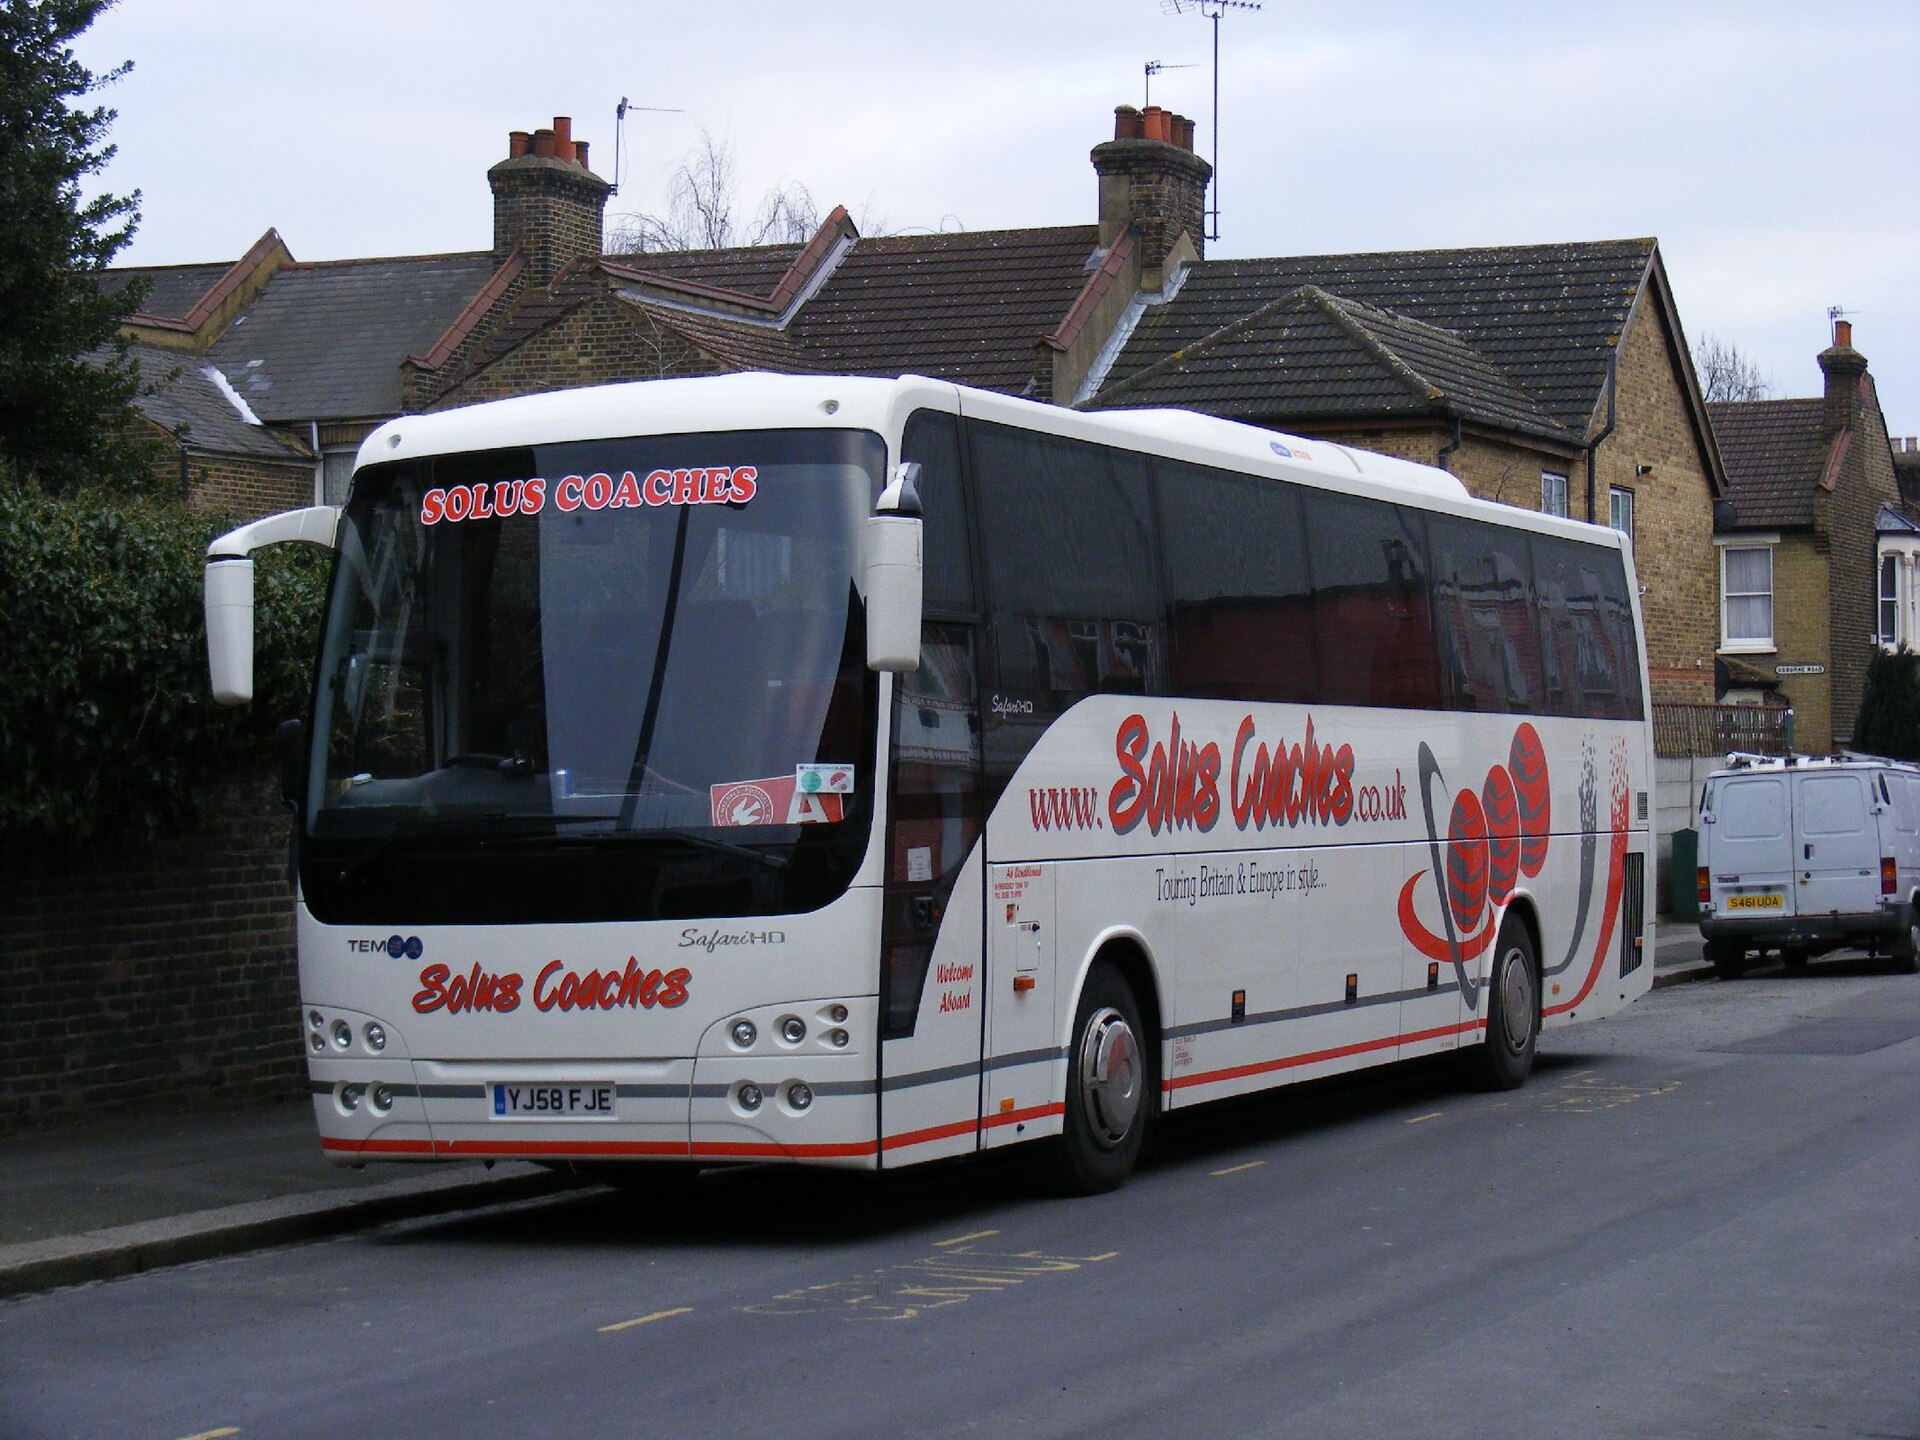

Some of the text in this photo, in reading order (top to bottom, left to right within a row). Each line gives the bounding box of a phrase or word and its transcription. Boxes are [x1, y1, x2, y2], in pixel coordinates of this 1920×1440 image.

[421, 466, 757, 525] SOLUS COACHES
[1156, 868, 1197, 906] Touring
[1200, 865, 1234, 897] Britain
[1237, 862, 1246, 894] &
[1250, 862, 1284, 899] Europe
[1286, 864, 1296, 890] in
[412, 955, 692, 1014] Solus Coaches
[937, 962, 974, 983] Welcome
[939, 987, 971, 1013] Aboard
[508, 1088, 611, 1110] YJ58 FJE
